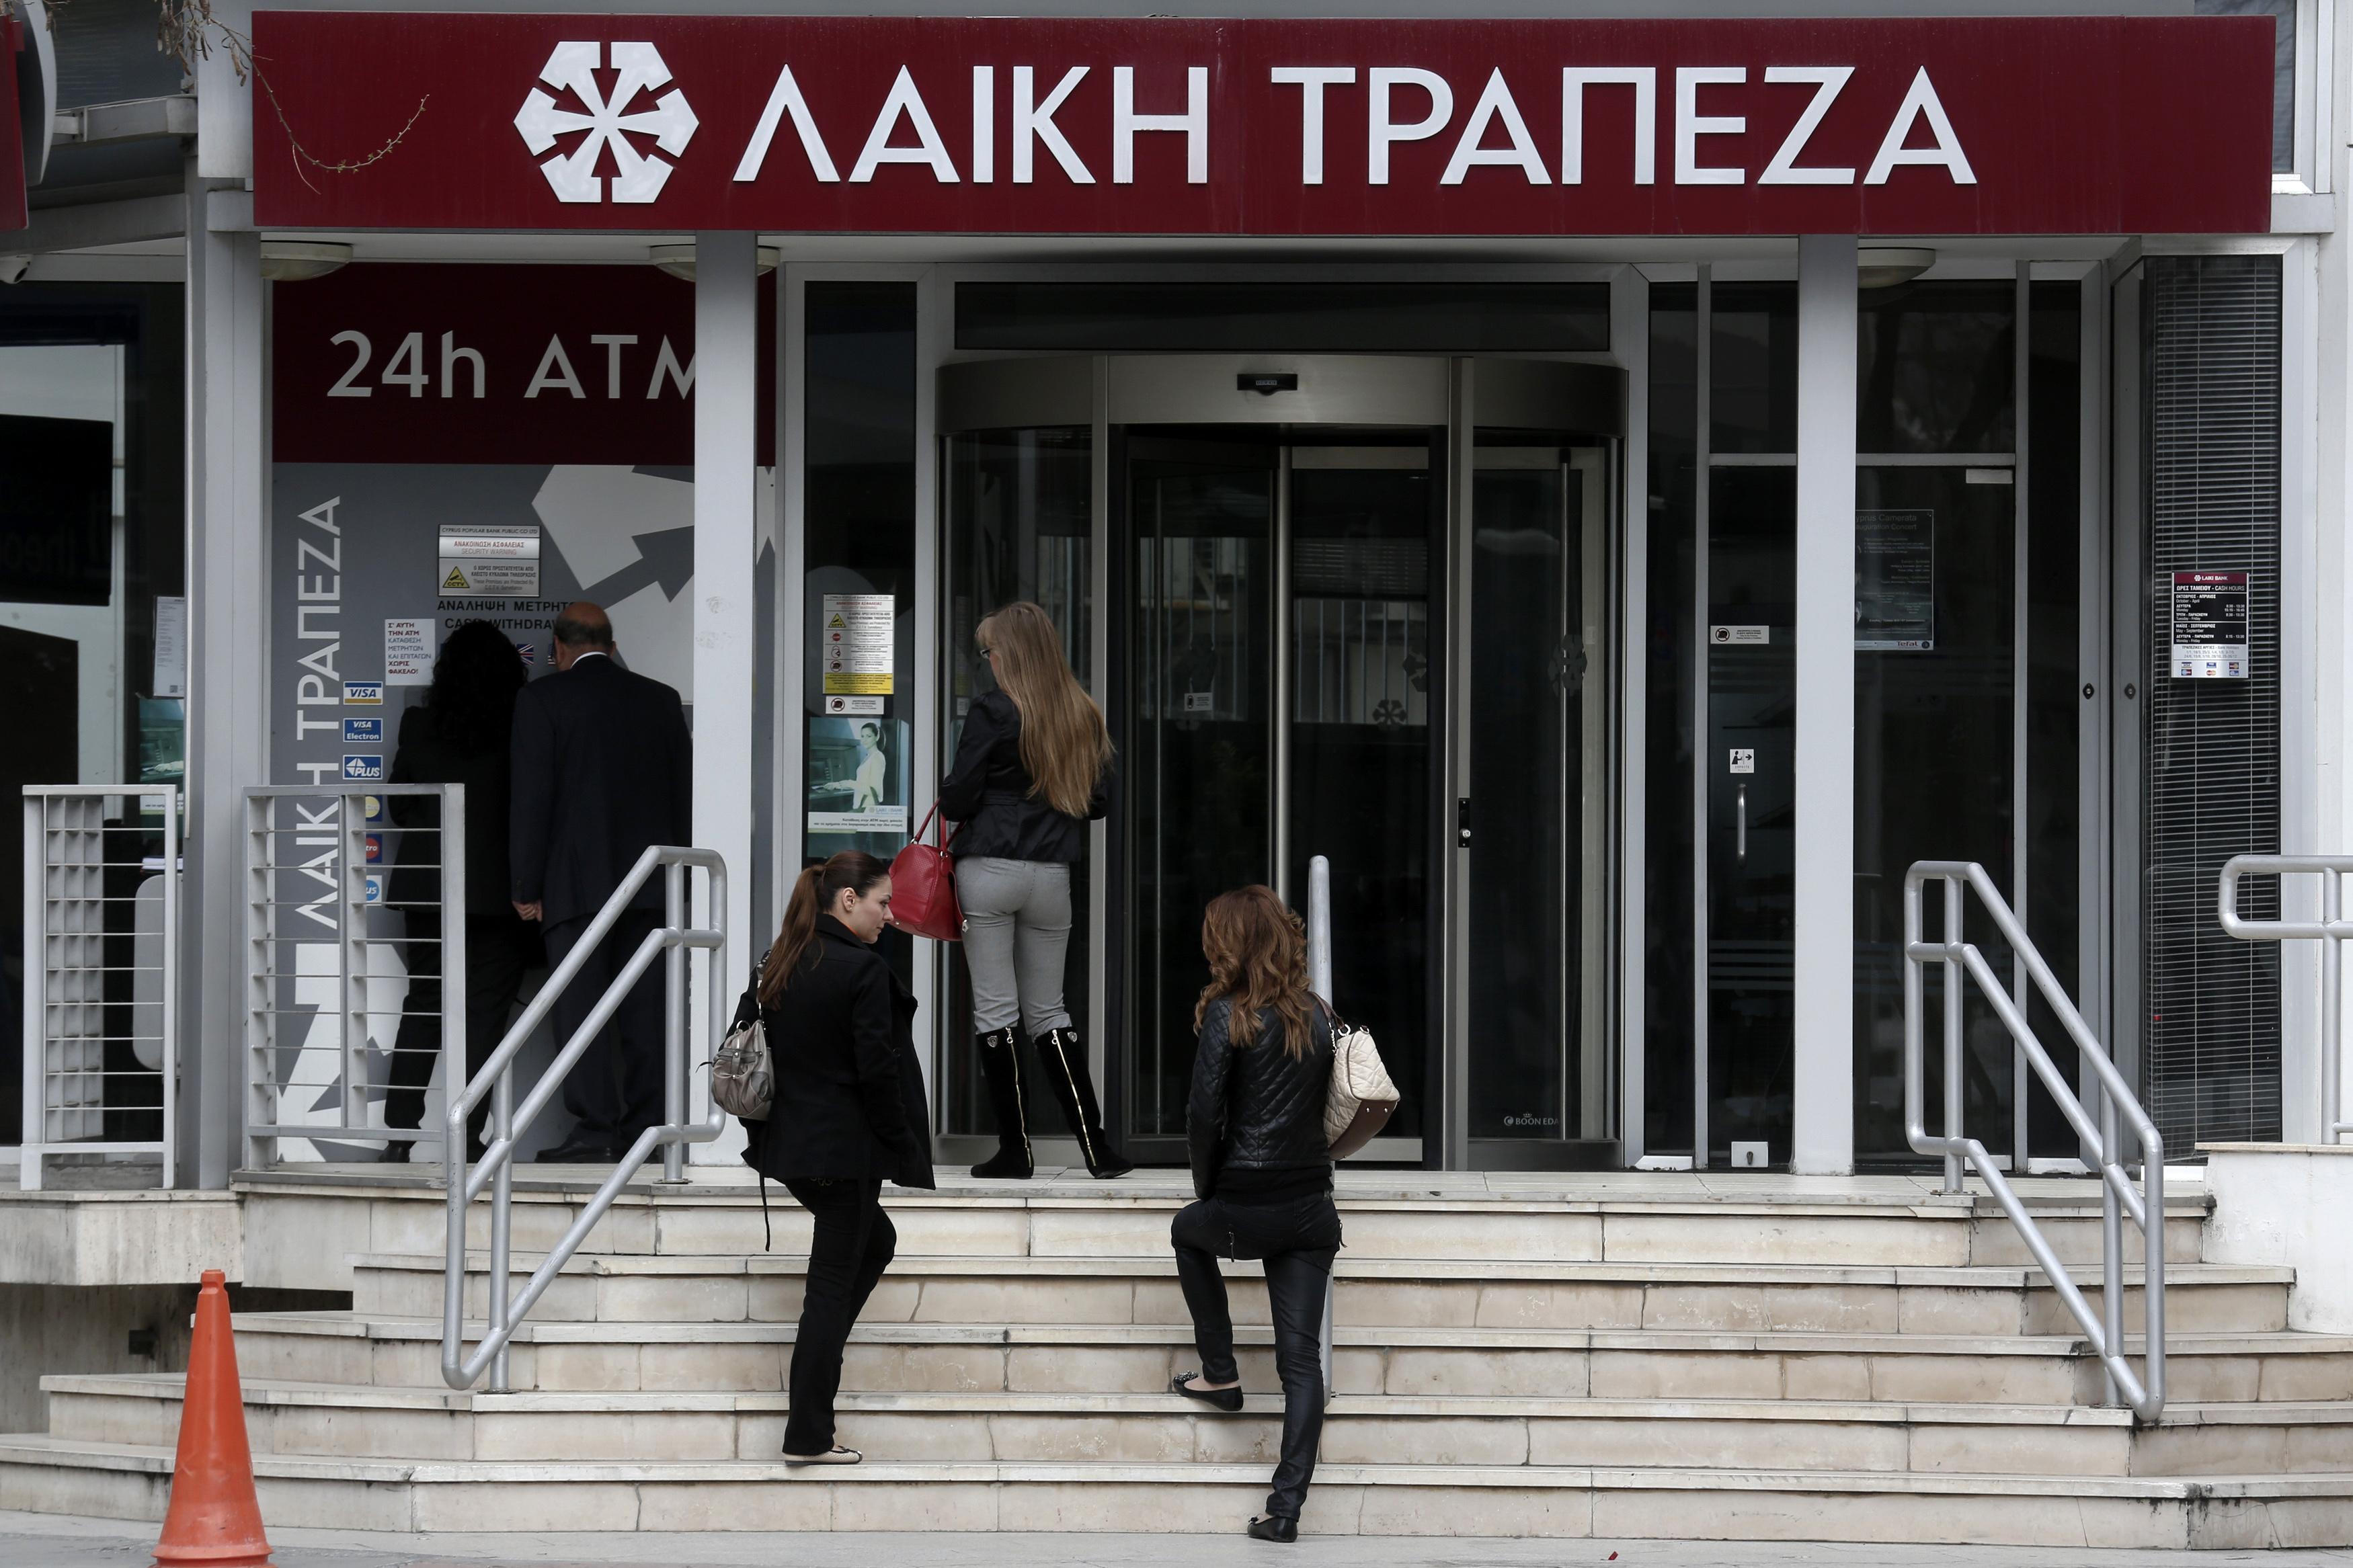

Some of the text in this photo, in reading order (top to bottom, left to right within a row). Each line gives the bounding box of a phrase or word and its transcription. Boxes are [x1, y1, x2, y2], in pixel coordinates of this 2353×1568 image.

[733, 63, 1977, 185] ΛΑΙΚΗ ΤΡΑΠΕΖΑ
[327, 330, 485, 398] 24h
[1856, 514, 1877, 522] yprus
[438, 601, 573, 612] ΑΝΑΛΗΨΗ ΜΕΤΡΗΤ
[489, 618, 555, 630] WITHDRA
[350, 689, 376, 698] VISA
[295, 496, 340, 930] ΛΑΙΚΗ ΤΡΑΠΕΖΑ
[354, 768, 380, 777] PLUS
